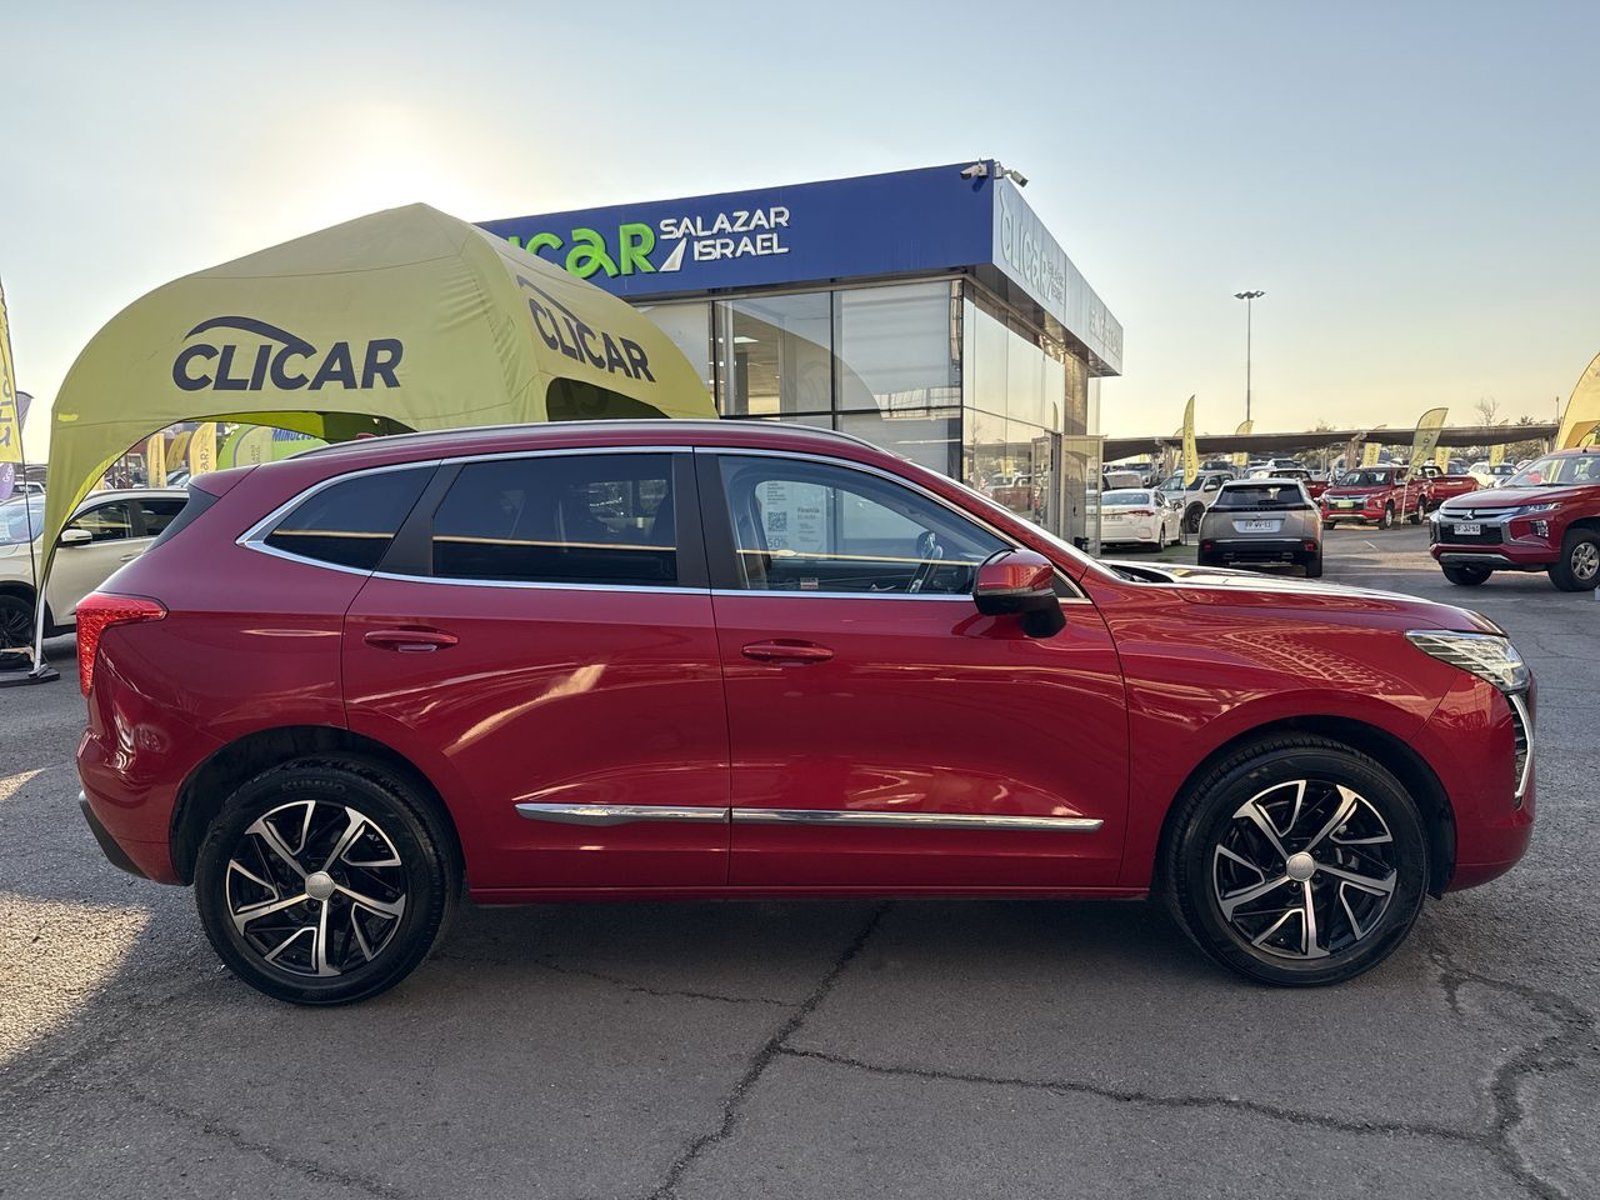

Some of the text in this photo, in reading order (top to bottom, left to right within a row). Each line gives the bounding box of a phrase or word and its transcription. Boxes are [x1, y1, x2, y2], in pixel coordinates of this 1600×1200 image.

[660, 206, 790, 240] SALAZAR
[694, 233, 789, 262] ISRAEL
[516, 278, 656, 383] CLICAR
[172, 325, 404, 392] CLICAR
